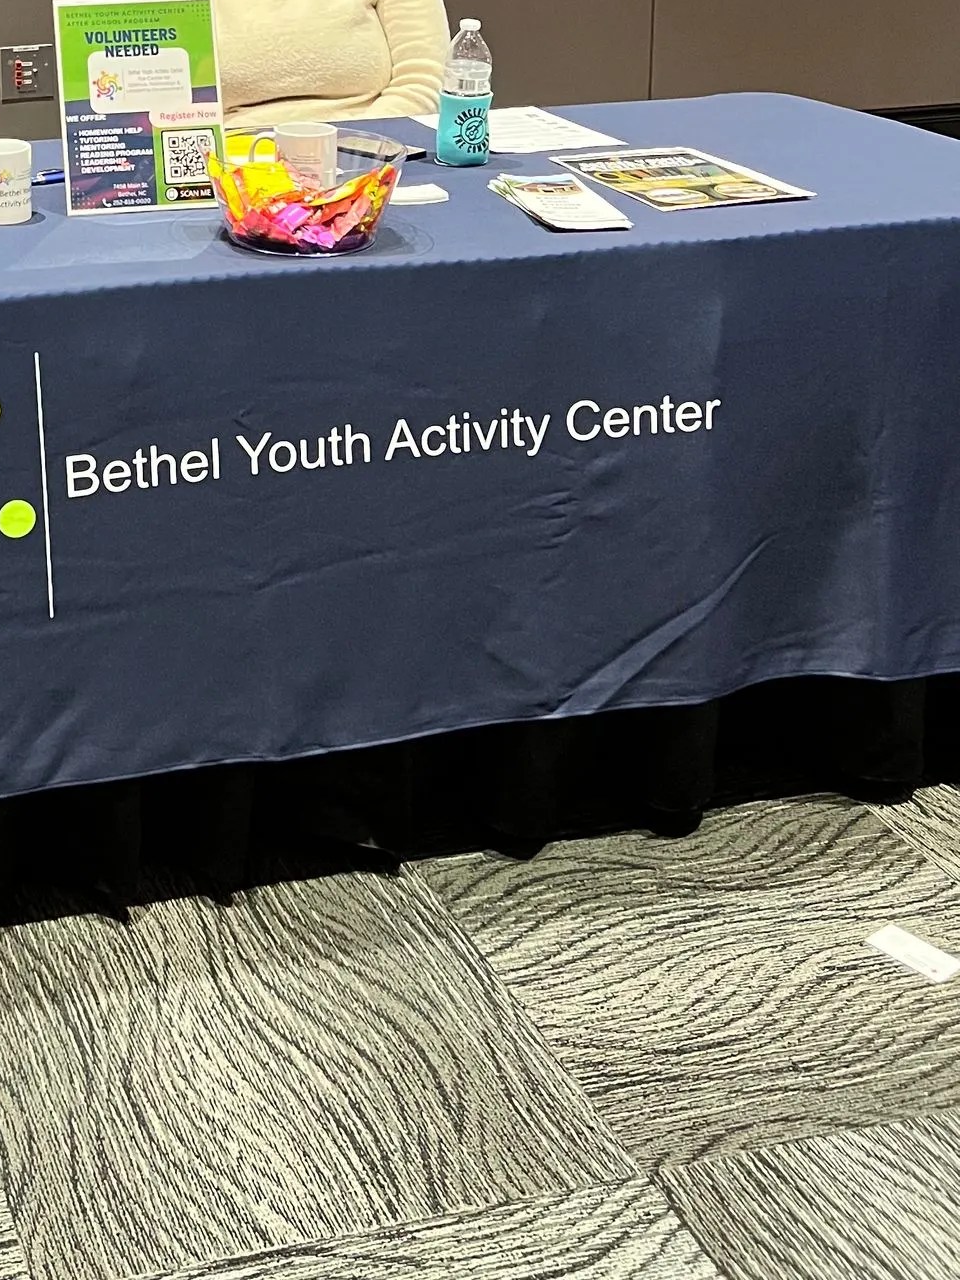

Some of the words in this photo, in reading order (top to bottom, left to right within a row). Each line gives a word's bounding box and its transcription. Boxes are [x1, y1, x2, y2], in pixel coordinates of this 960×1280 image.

[121, 9, 155, 17] ACTIVITY
[123, 17, 160, 25] PROGRAM
[85, 27, 177, 45] VOLUNTEERS
[104, 43, 159, 58] NEEDED
[159, 111, 194, 121] Register
[197, 111, 217, 119] Now
[454, 107, 487, 126] CONCERT
[79, 128, 124, 137] HOMEWORK
[79, 136, 119, 144] TUTORING
[79, 143, 126, 152] MENTORING
[80, 151, 115, 159] READING
[116, 149, 154, 157] PROGRAM
[81, 157, 127, 166] LEADERSHIP
[81, 164, 136, 174] DEVELOPMENT
[0, 189, 22, 197] Bethel
[180, 189, 199, 198] SCAN
[200, 189, 212, 197] ME
[65, 437, 221, 498] Bethel
[236, 423, 371, 476] Youth
[385, 407, 551, 458] Activity
[565, 395, 722, 442] Center
